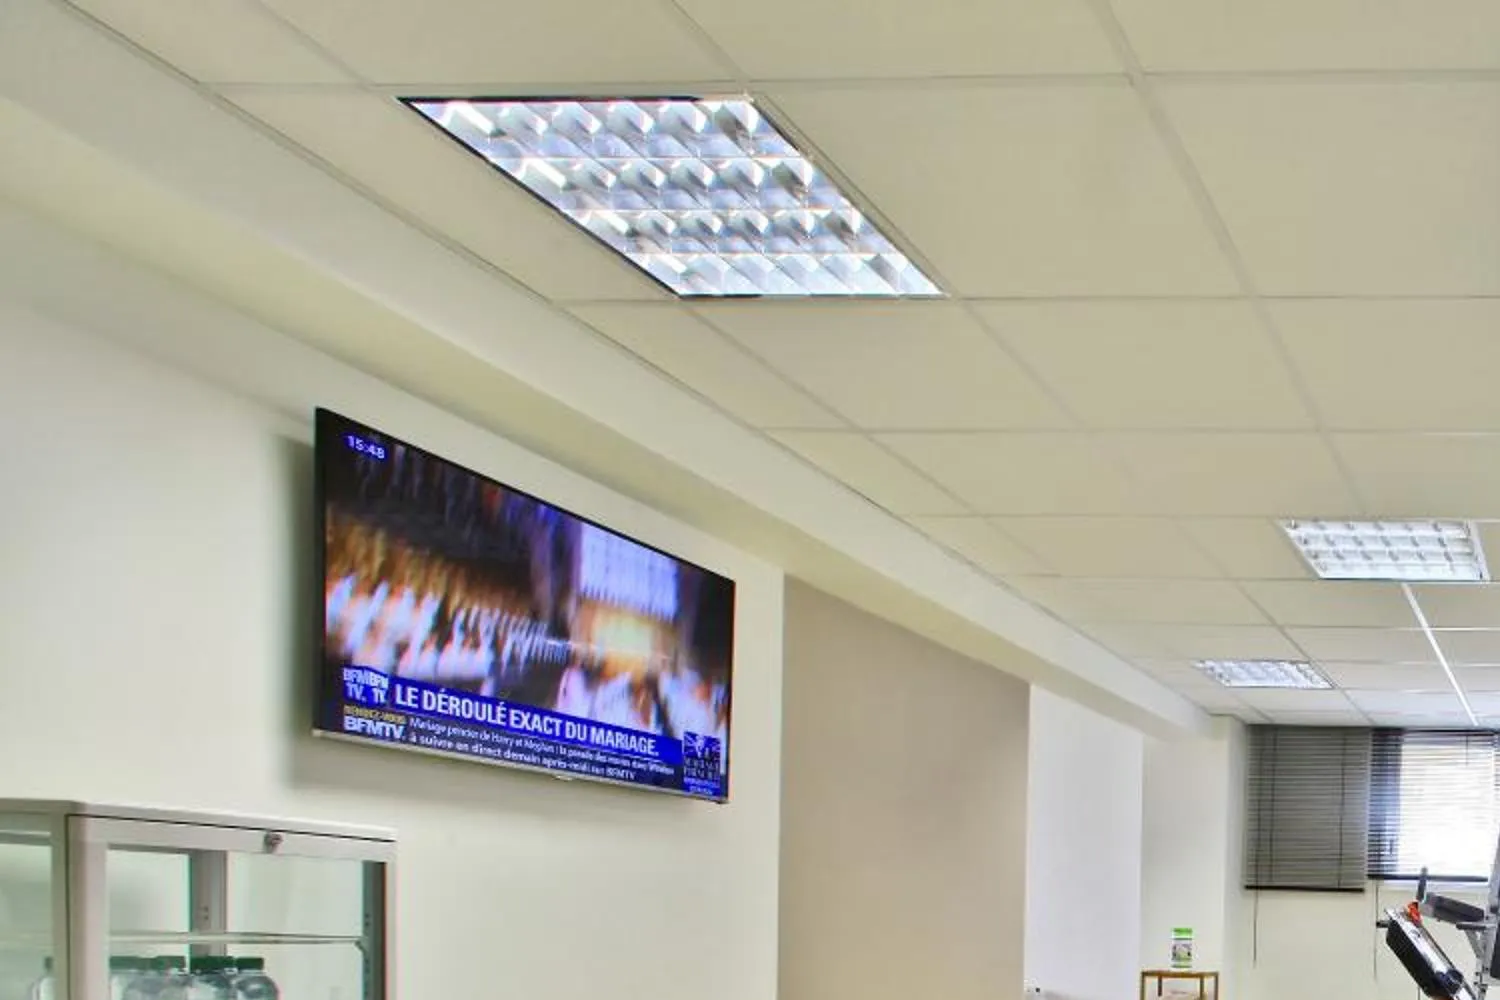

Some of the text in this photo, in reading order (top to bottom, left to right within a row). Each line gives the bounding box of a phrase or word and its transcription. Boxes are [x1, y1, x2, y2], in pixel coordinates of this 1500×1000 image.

[347, 435, 385, 459] 15:48
[395, 683, 660, 756] LE DÉROULÉ EXACT DU MARIAGE.
[420, 735, 453, 749] suivre
[471, 744, 501, 757] direct
